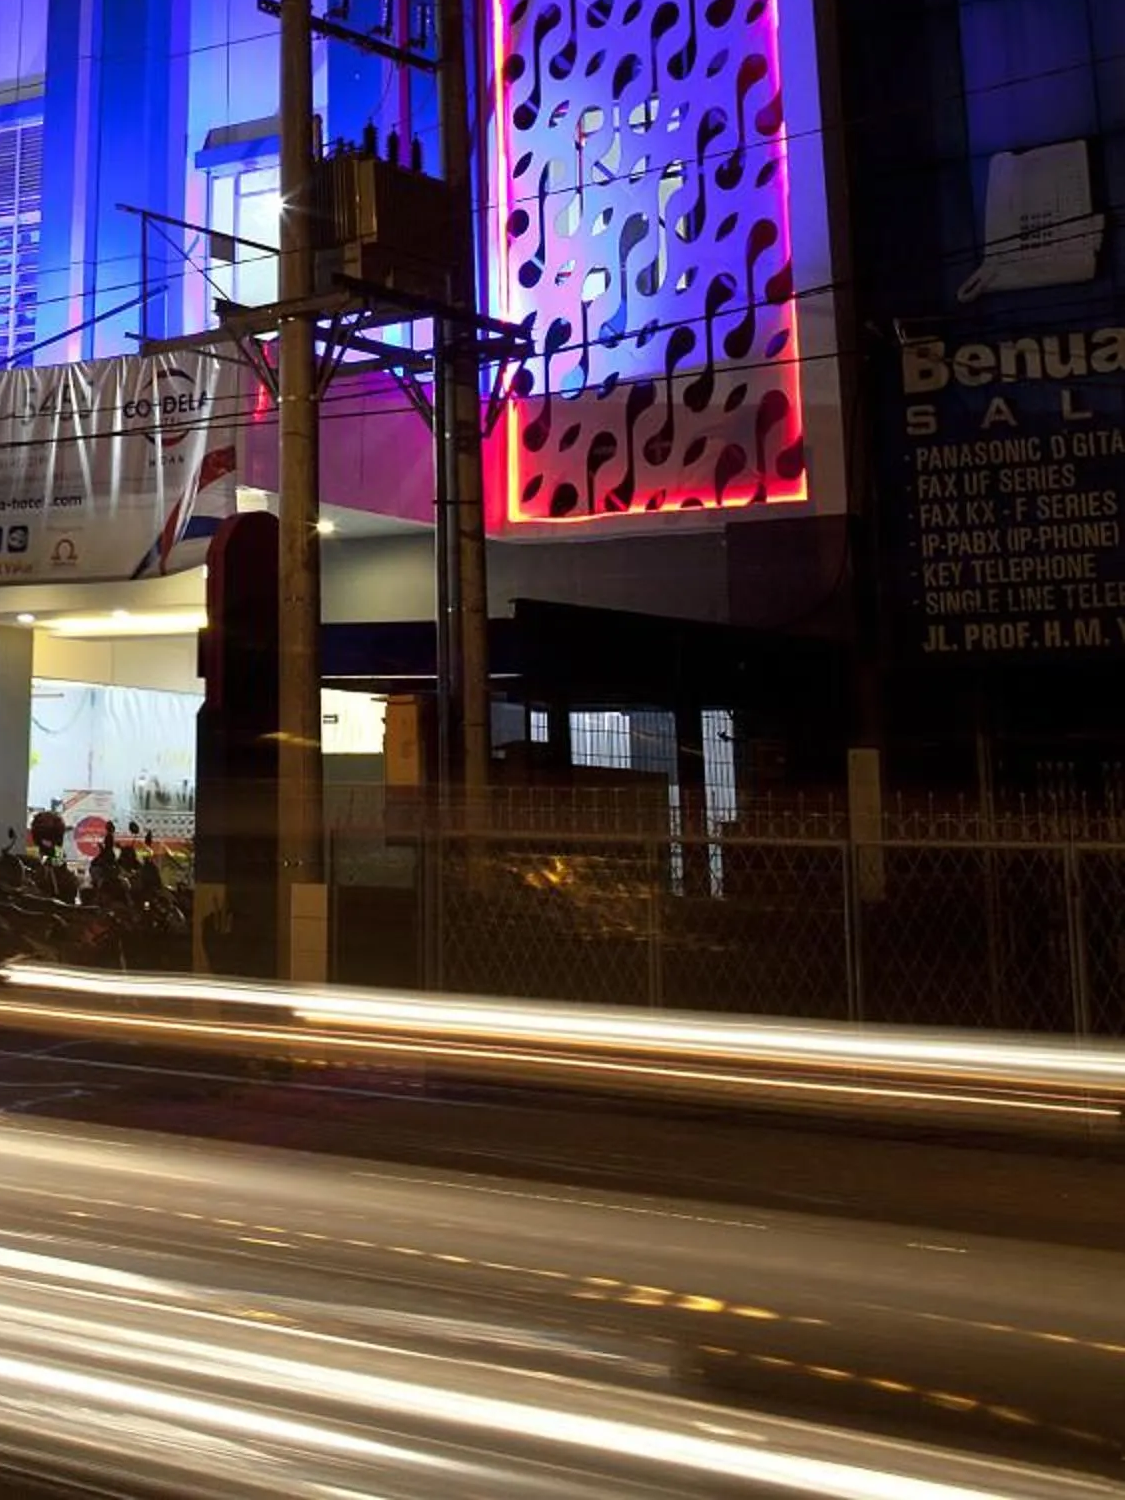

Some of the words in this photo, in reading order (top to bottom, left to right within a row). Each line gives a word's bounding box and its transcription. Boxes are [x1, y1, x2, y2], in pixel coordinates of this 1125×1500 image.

[903, 327, 1125, 395] Benua
[124, 390, 208, 419] CODELA
[916, 436, 1041, 471] PANASONIC
[1051, 428, 1125, 461] DGITA
[918, 473, 958, 500] FAX
[964, 470, 991, 497] UF
[999, 463, 1076, 494] SERIES
[919, 502, 959, 530] FAX
[966, 499, 996, 526] KX
[1037, 490, 1119, 520] SERIES
[922, 526, 1002, 557] IP-PABX
[1007, 520, 1120, 552] (IP-PHONE)
[923, 560, 962, 588] KEY
[973, 553, 1097, 584] TELEPHONE
[926, 587, 1000, 616] SINGLE
[1007, 584, 1057, 612] LINE
[923, 624, 958, 653] JL.
[964, 620, 1040, 651] PROF.
